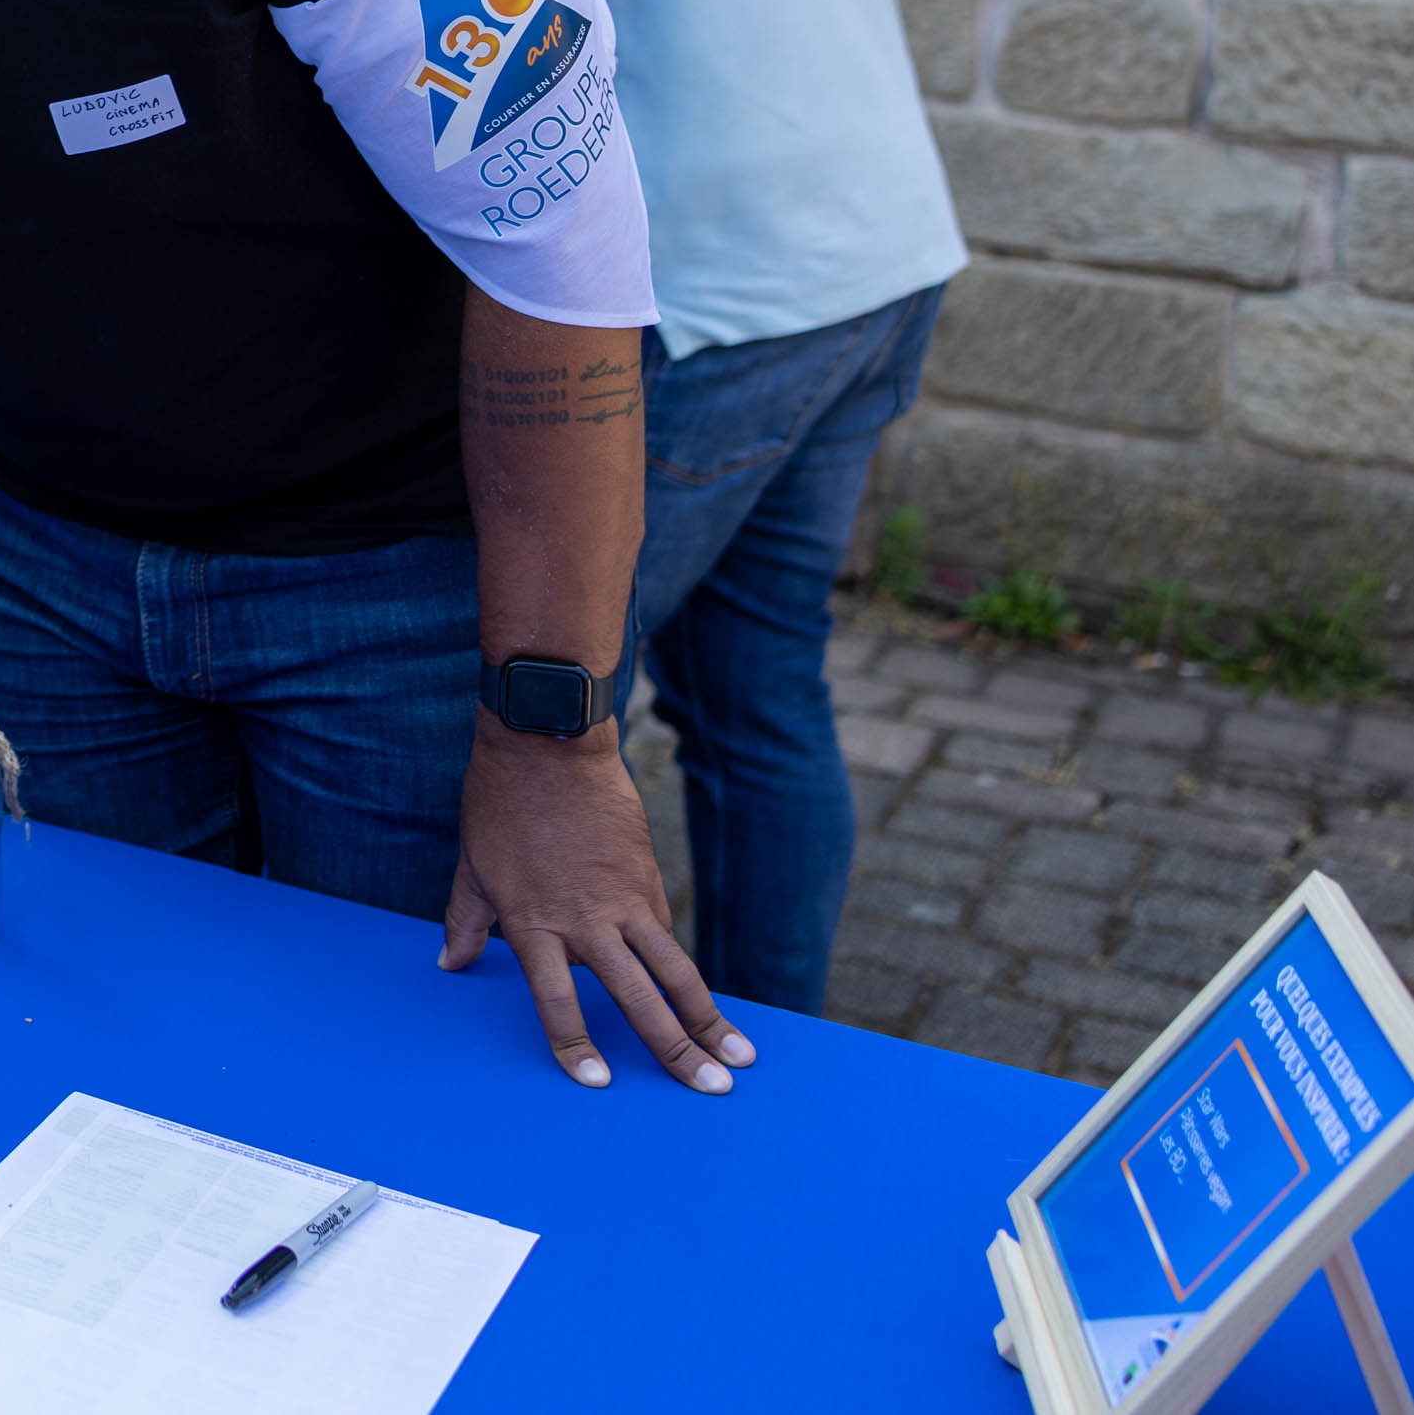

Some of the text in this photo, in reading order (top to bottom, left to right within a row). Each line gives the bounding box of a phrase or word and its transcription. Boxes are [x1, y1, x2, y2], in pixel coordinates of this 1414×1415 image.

[484, 23, 587, 134] COURTIER EN ASSURANCES
[527, 14, 563, 66] ans
[479, 54, 602, 188] GROUPE
[480, 77, 614, 238] ROEDERER
[1250, 988, 1285, 1041] POUR
[1275, 1028, 1309, 1081] VOUS
[1276, 965, 1383, 1133] QUELQUES EXEMPLES
[1197, 1087, 1215, 1115] Star
[306, 1213, 343, 1246] Sharpie
